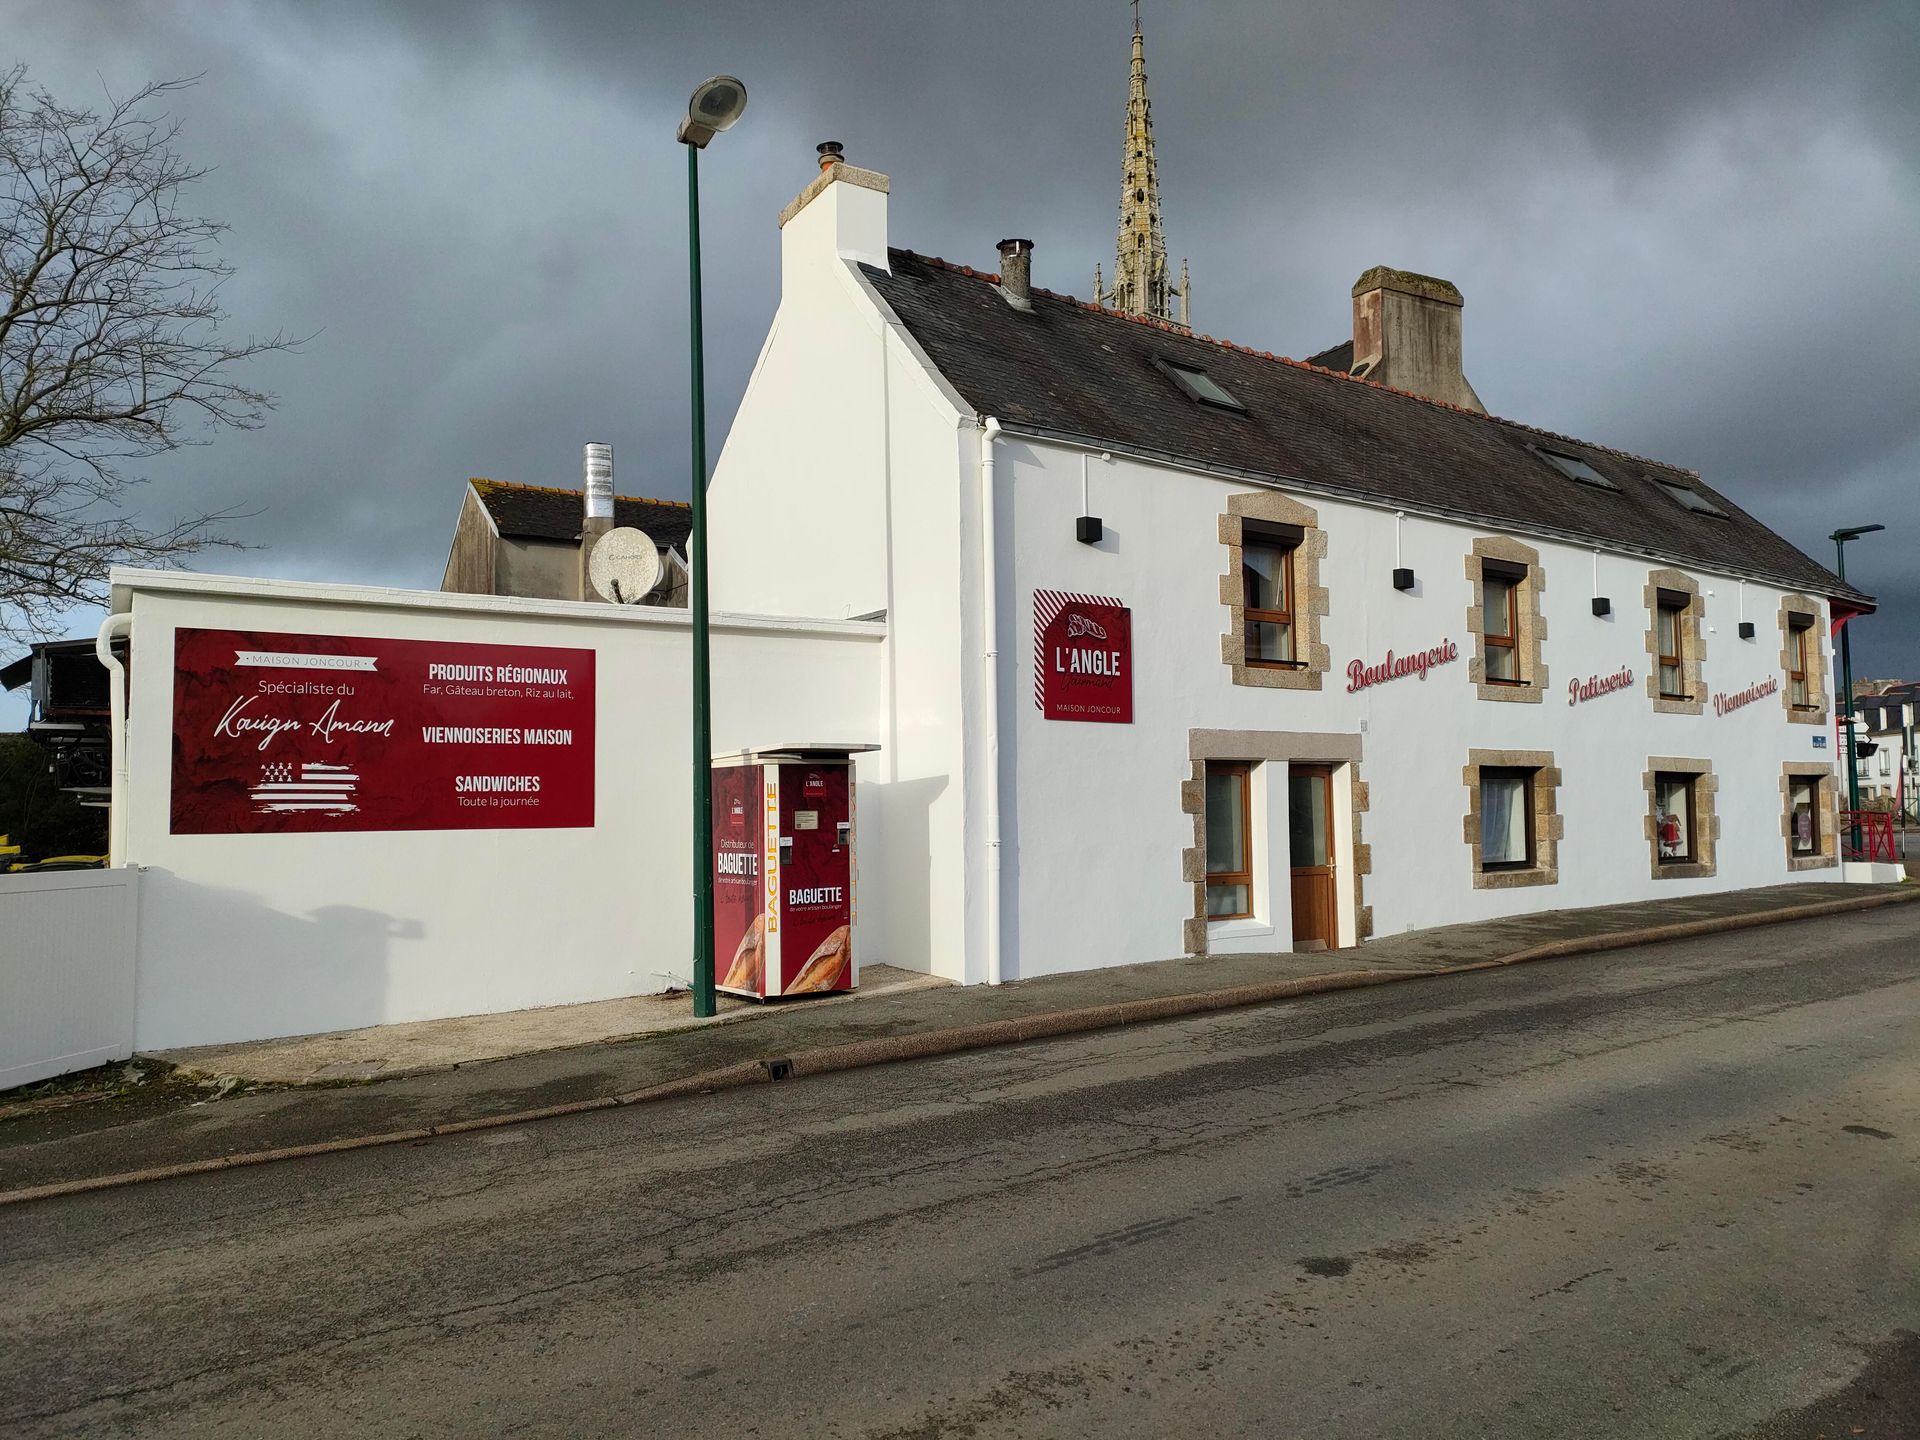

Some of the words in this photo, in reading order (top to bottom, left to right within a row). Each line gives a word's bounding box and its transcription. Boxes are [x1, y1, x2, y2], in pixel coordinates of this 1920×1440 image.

[252, 655, 300, 665] MAISON
[304, 657, 361, 667] JONCOUR
[1056, 647, 1121, 676] L'ANGLE
[1347, 637, 1458, 693] Boulangerie
[429, 663, 493, 682] PRODUITS
[496, 664, 568, 685] RÉGIONAUX
[258, 680, 334, 695] Spécialiste
[337, 683, 355, 695] du
[423, 684, 443, 696] Far,
[445, 684, 484, 696] Gâteau
[486, 686, 523, 698] breton,
[525, 688, 541, 698] Riz
[543, 689, 555, 698] au
[557, 689, 574, 700] lait,
[1713, 674, 1778, 717] Viennoiserie
[1056, 703, 1085, 712] MAISON
[1087, 705, 1121, 714] JONCOUR
[213, 695, 302, 751] Kouign
[309, 699, 395, 744] Amann
[422, 726, 521, 744] VIENNOISERIES
[523, 729, 572, 745] MAISON
[455, 775, 540, 792] SANDWICHES
[457, 796, 487, 806] Toute
[489, 796, 499, 806] la
[500, 796, 540, 808] journée
[721, 838, 747, 849] Distributeur
[747, 840, 754, 849] de
[718, 852, 758, 876] BAGUETTE
[767, 783, 777, 932] BAGUETTE
[789, 887, 842, 905] BAGUETTE
